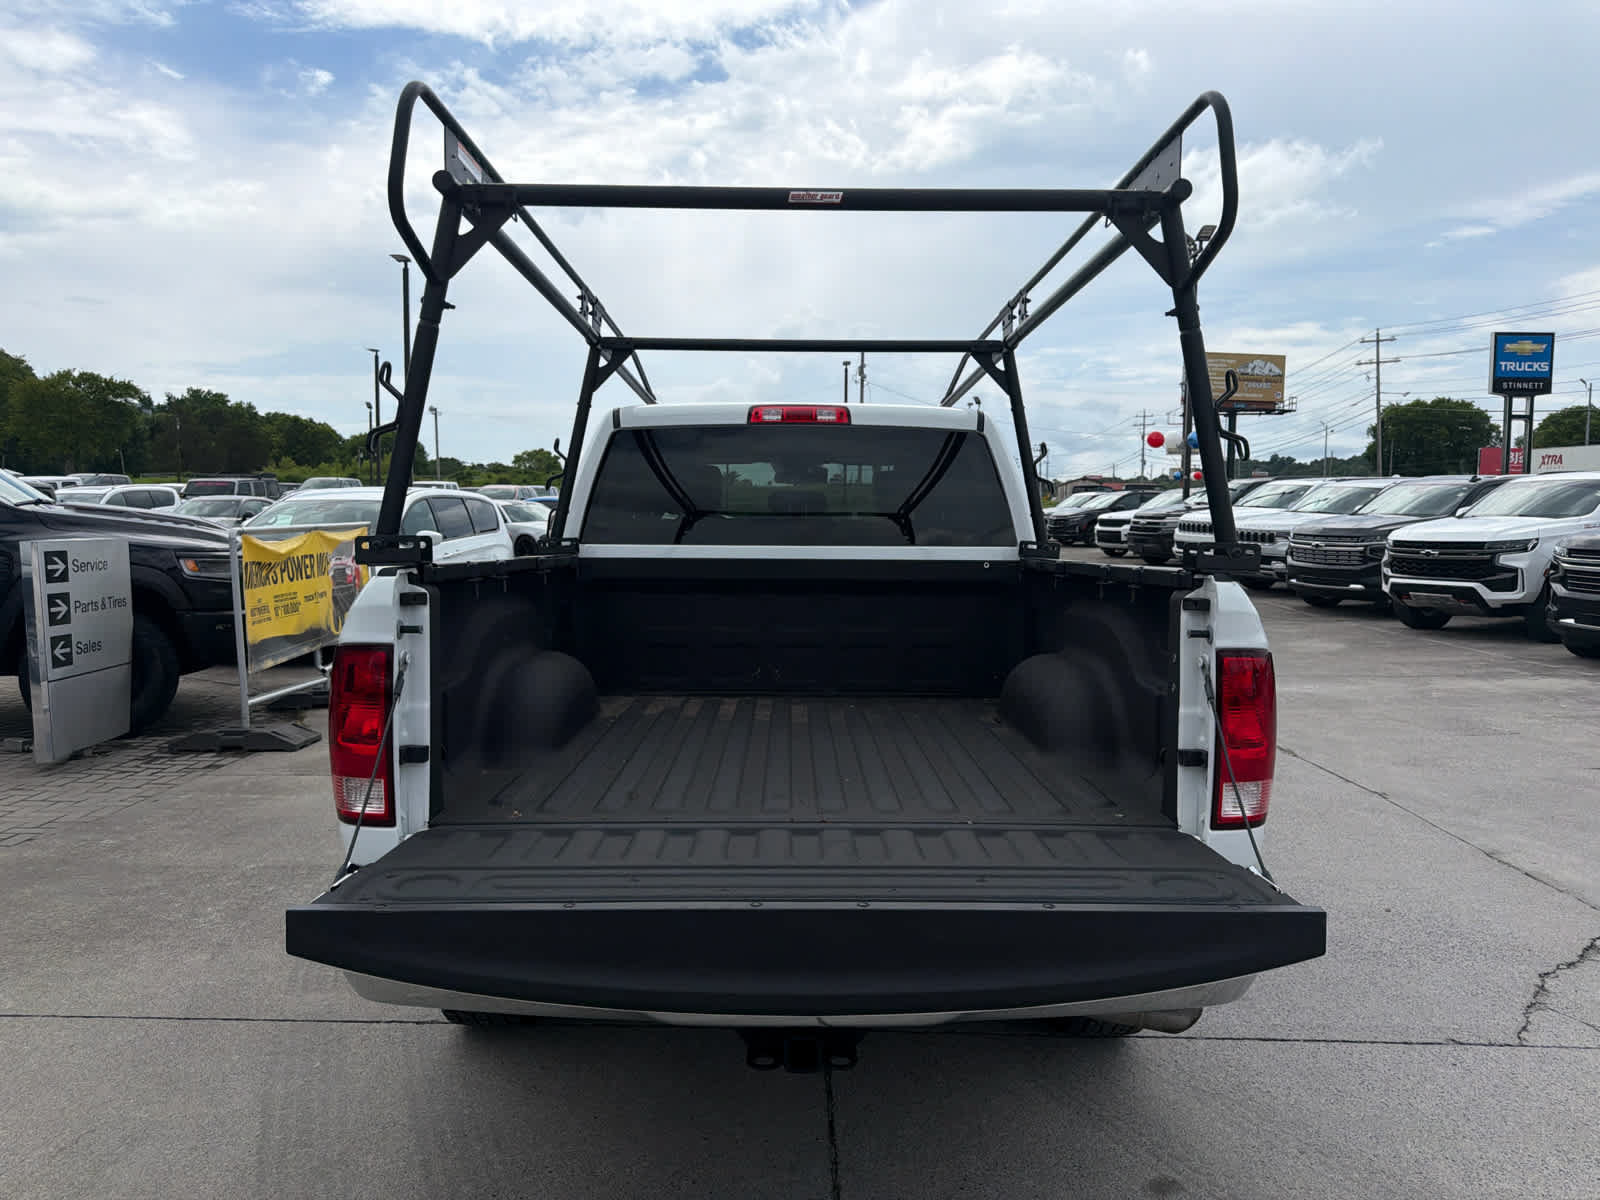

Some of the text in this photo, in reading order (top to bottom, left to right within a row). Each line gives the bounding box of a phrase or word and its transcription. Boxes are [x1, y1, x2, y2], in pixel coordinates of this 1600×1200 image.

[1500, 361, 1550, 372] TRUCKS
[1539, 454, 1563, 468] XTRA
[72, 559, 108, 573] Service
[280, 553, 315, 584] POWER
[74, 596, 127, 614] Parts & Tires
[75, 640, 102, 655] Sales
